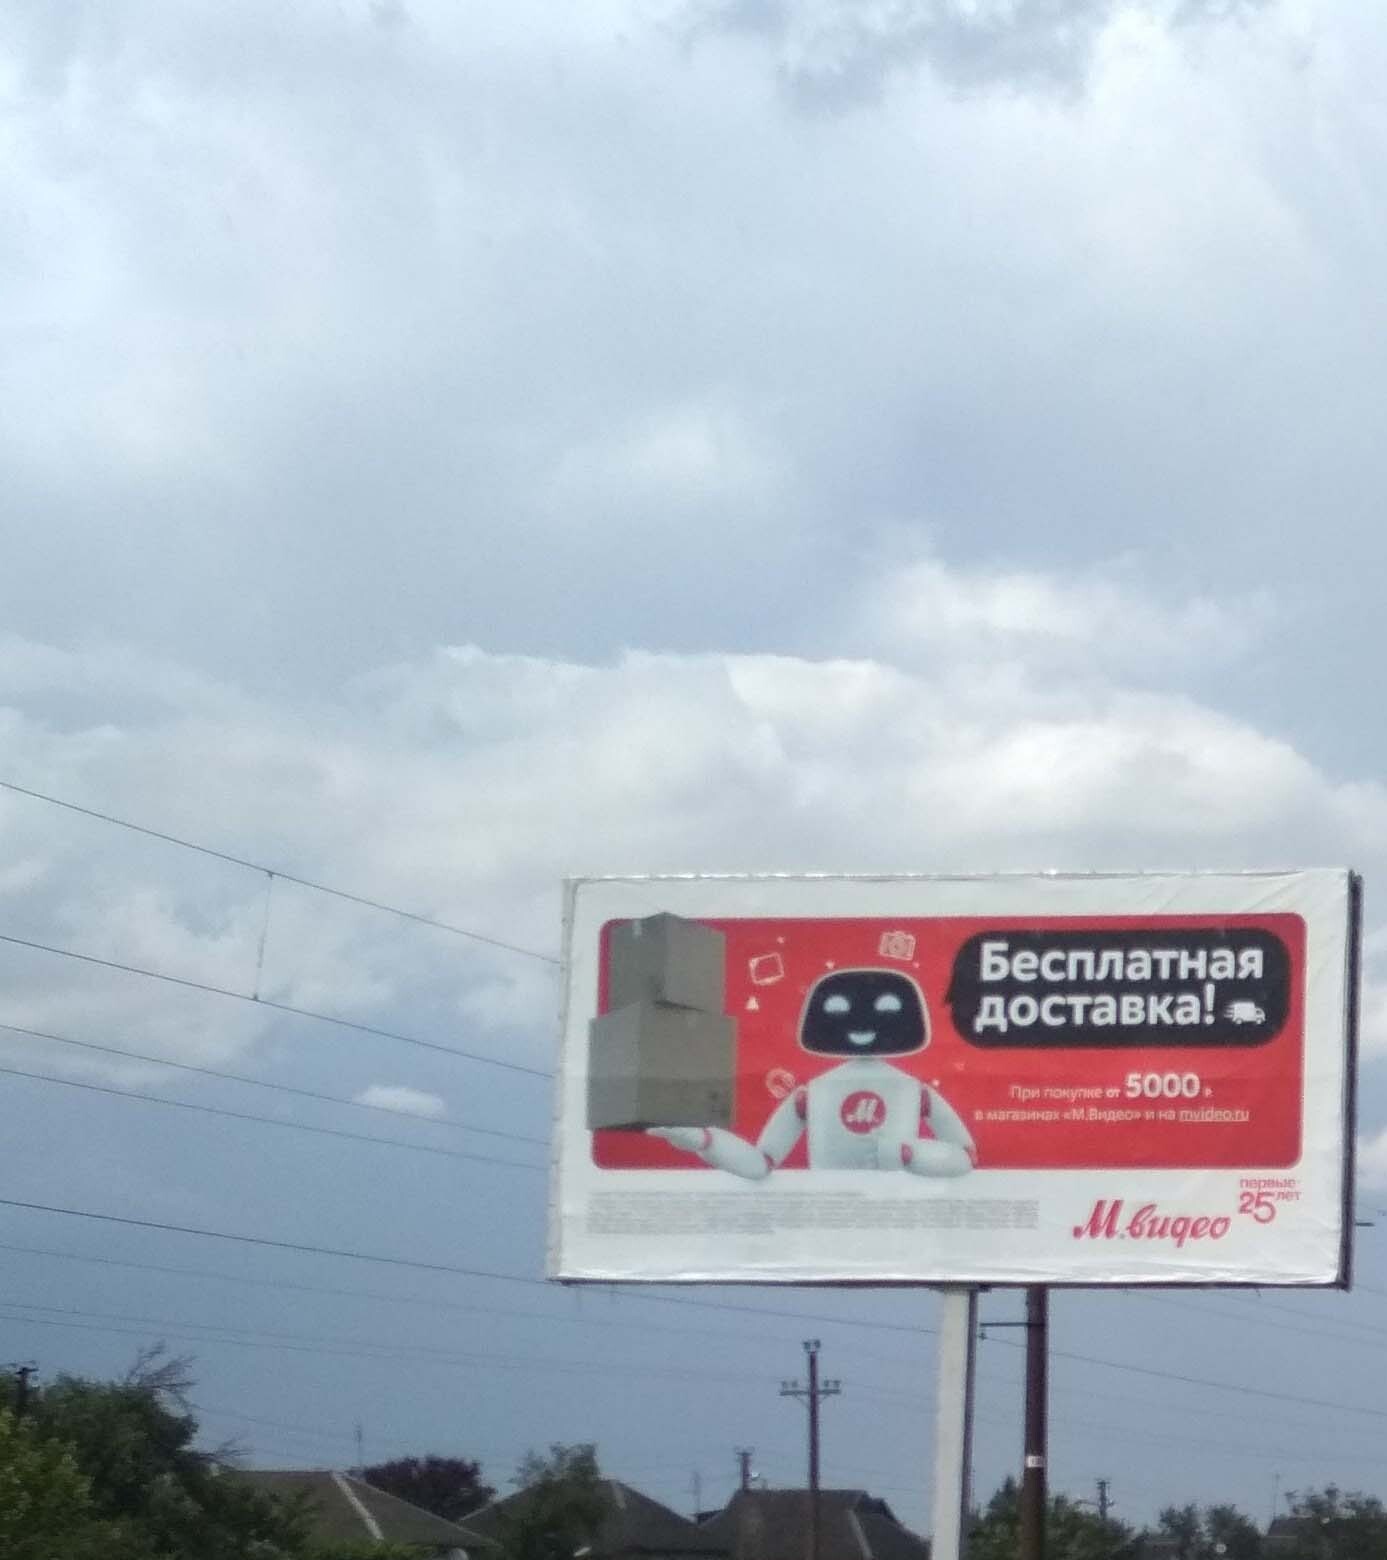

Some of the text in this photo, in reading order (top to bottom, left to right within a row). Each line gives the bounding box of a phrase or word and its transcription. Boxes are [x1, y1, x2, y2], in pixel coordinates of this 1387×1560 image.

[978, 941, 1264, 982] Бесплатная
[974, 982, 1216, 1033] доставка!
[1010, 1086, 1041, 1101] При
[1044, 1088, 1102, 1102] покупке
[1105, 1088, 1121, 1098] от
[1125, 1072, 1201, 1098] 5000
[986, 1110, 1060, 1121] магазинах
[1145, 1110, 1155, 1120] и
[1158, 1109, 1176, 1121] на
[1178, 1106, 1250, 1122] mvideo.ru
[1239, 1178, 1296, 1191] первые
[1238, 1191, 1302, 1225] 25 лет
